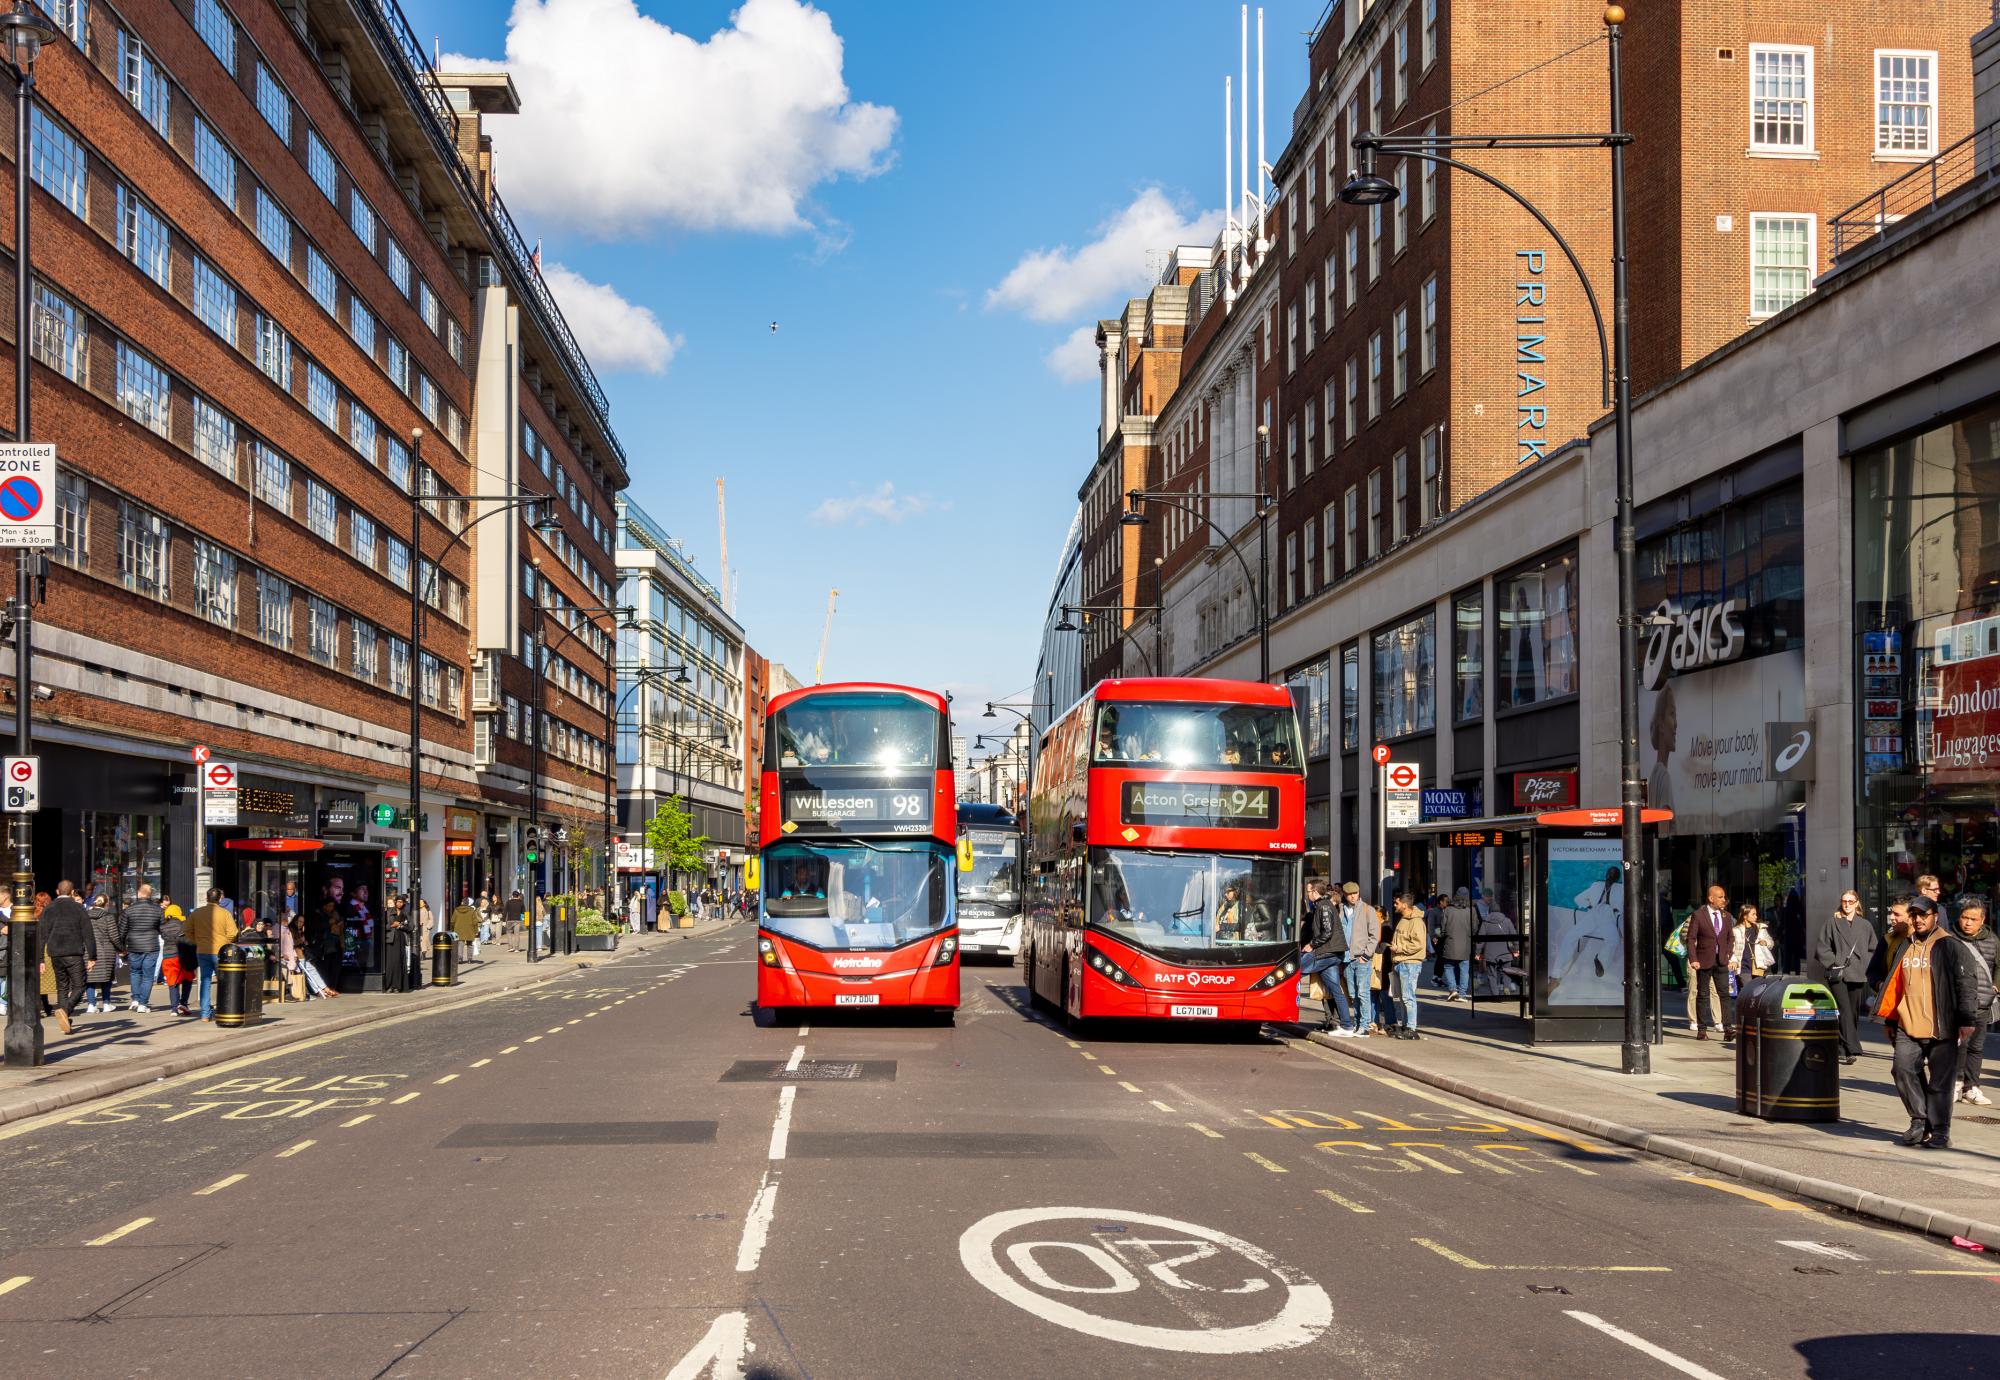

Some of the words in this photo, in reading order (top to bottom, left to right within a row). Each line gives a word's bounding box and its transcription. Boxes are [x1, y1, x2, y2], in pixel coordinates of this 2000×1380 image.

[1516, 250, 1548, 464] PRIMARK
[0, 447, 50, 456] ontrolled
[0, 460, 41, 471] ZONE
[1936, 680, 2000, 718] London
[1690, 736, 1713, 758] Move
[1713, 736, 1733, 760] your
[1735, 728, 1759, 756] body,
[196, 748, 207, 760] K
[1378, 747, 1387, 760] P
[1694, 771, 1717, 789] move
[1718, 769, 1738, 792] your
[1739, 760, 1764, 784] mind.
[1524, 778, 1561, 792] Pizza
[1132, 792, 1177, 806] Acton
[1182, 793, 1227, 808] Green
[1231, 789, 1268, 814] 94
[1425, 792, 1466, 804] MONEY
[1530, 790, 1559, 802] Hut
[795, 795, 874, 809] Willesden
[892, 794, 921, 816] 98
[1425, 805, 1466, 814] EXCHANGE
[1624, 862, 1630, 870] 9
[832, 957, 883, 968] Metroline
[1902, 957, 1931, 968] BOS
[1155, 973, 1185, 983] RATP
[1201, 975, 1235, 984] GROUP
[1176, 1007, 1194, 1015] LG71
[1197, 1007, 1213, 1015] DWU
[191, 1073, 408, 1095] BUS
[67, 1097, 387, 1125] STOP
